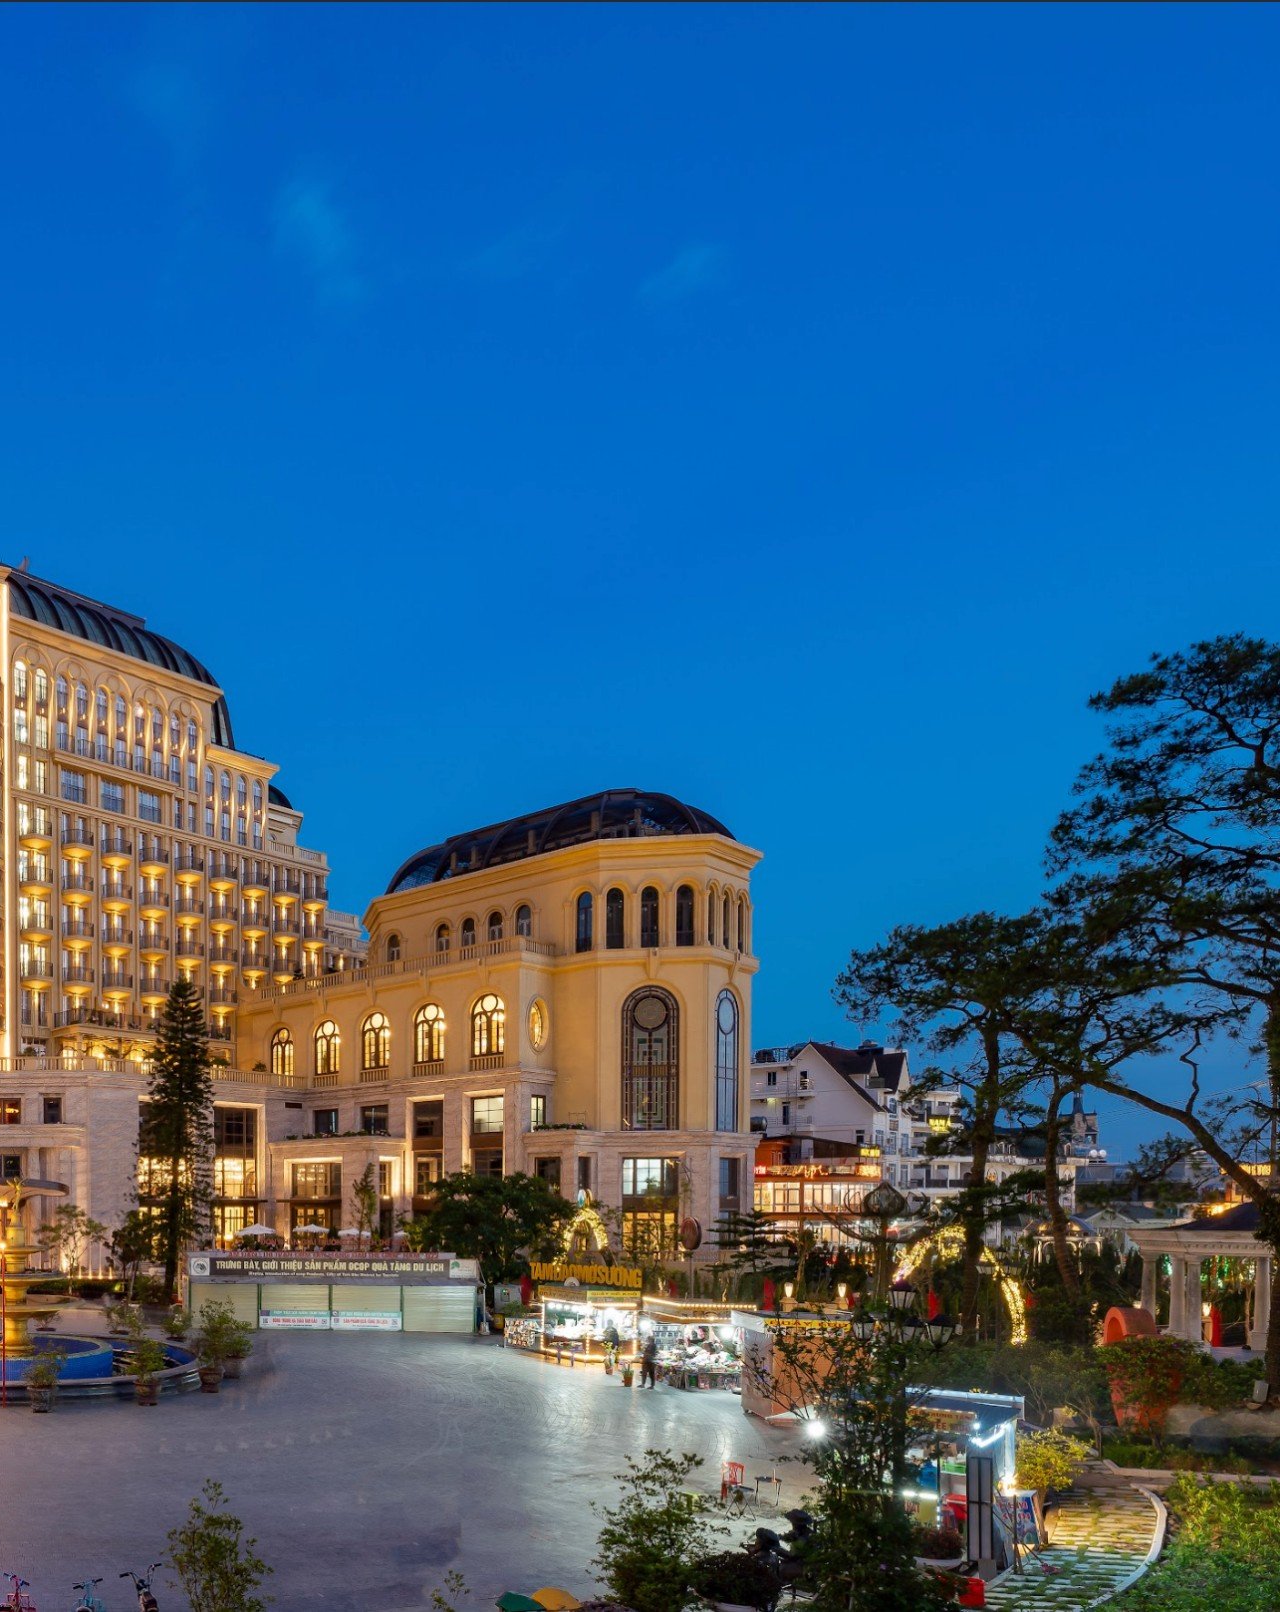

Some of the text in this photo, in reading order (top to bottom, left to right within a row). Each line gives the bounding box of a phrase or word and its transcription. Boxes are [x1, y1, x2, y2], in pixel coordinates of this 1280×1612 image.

[216, 1260, 242, 1270] TRƯNG
[244, 1259, 260, 1271] BÀY,
[262, 1259, 279, 1270] GIỚI
[280, 1260, 303, 1272] THIỆU
[305, 1258, 321, 1271] SẢN
[323, 1258, 347, 1271] PHẨM
[348, 1262, 370, 1272] OCOP
[372, 1260, 388, 1272] QUÀ
[390, 1261, 411, 1273] TẶNG
[413, 1262, 424, 1272] DU
[426, 1262, 444, 1273] LỊCH
